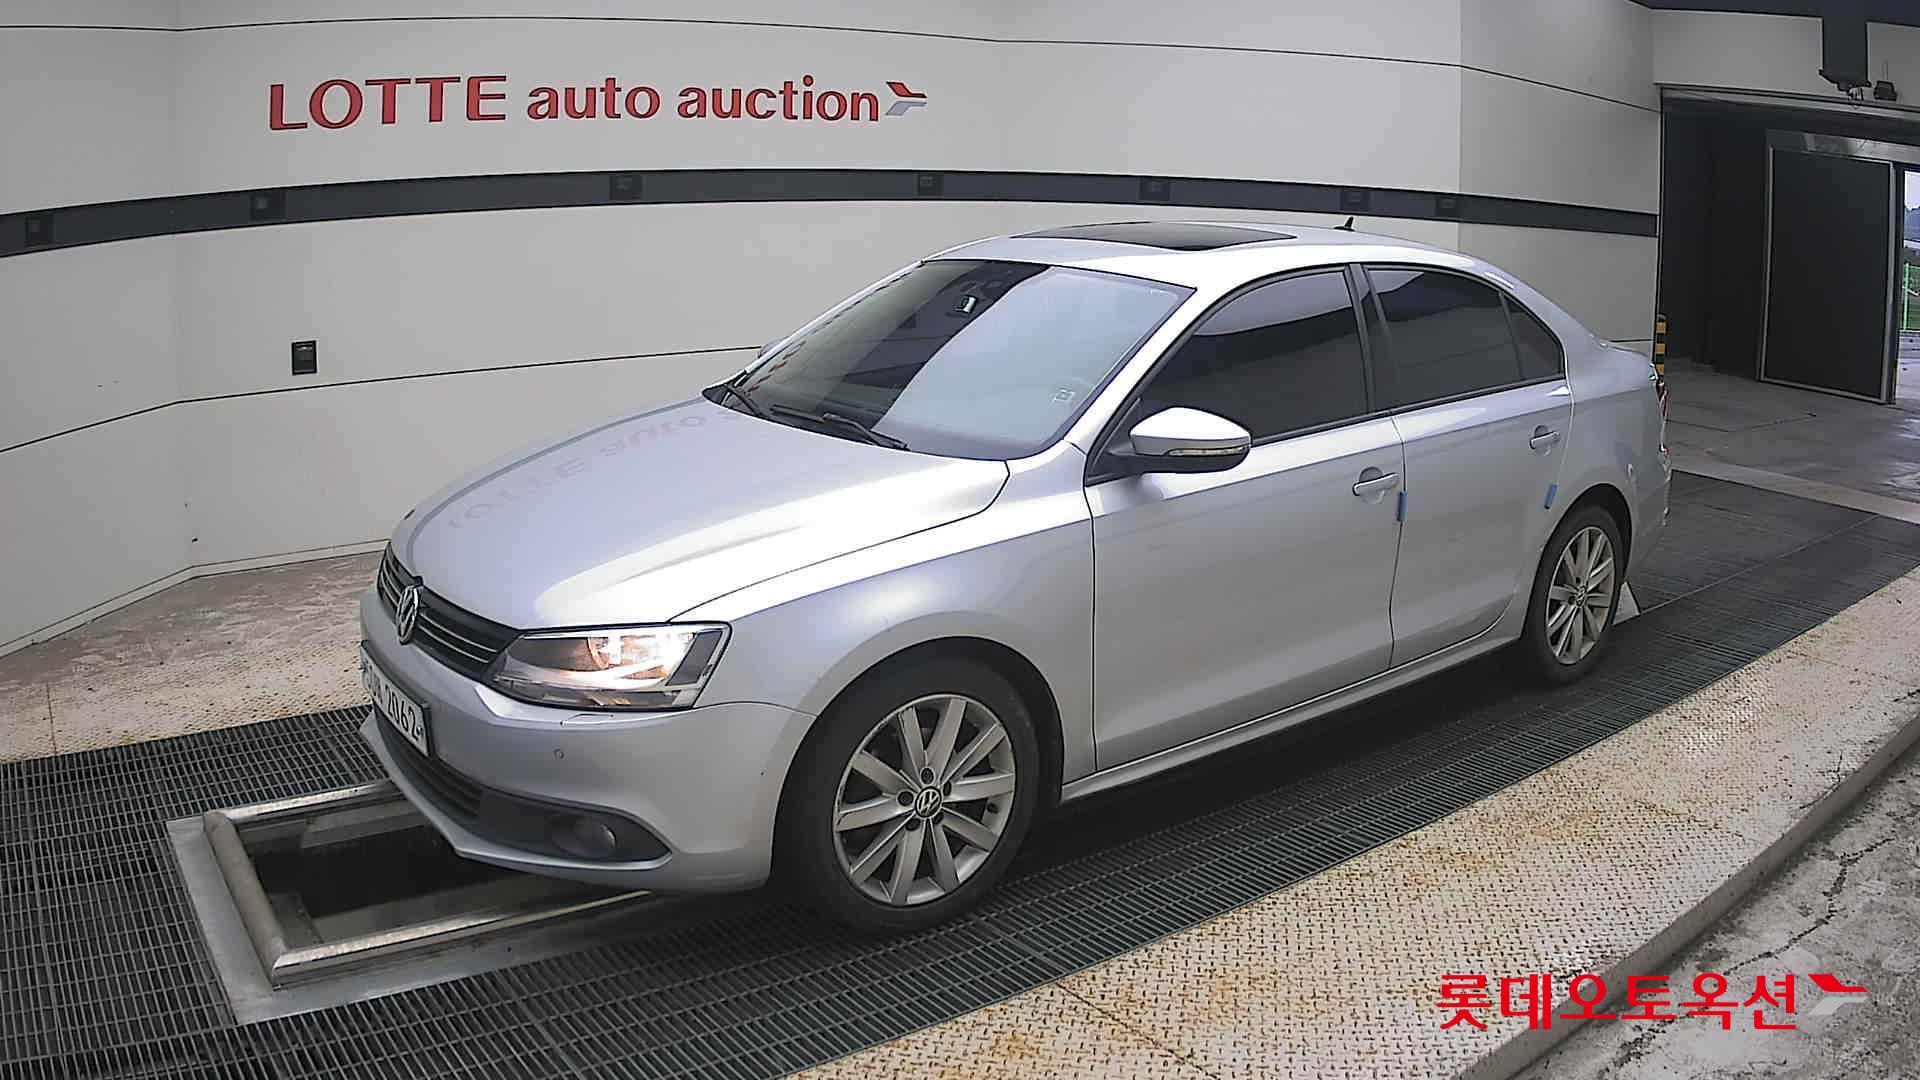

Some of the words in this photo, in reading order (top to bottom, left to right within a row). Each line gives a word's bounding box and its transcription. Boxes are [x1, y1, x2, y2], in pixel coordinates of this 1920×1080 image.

[269, 75, 507, 131] LOTTE
[526, 77, 662, 121] auto
[676, 75, 880, 122] auction
[385, 683, 419, 741] 2062
